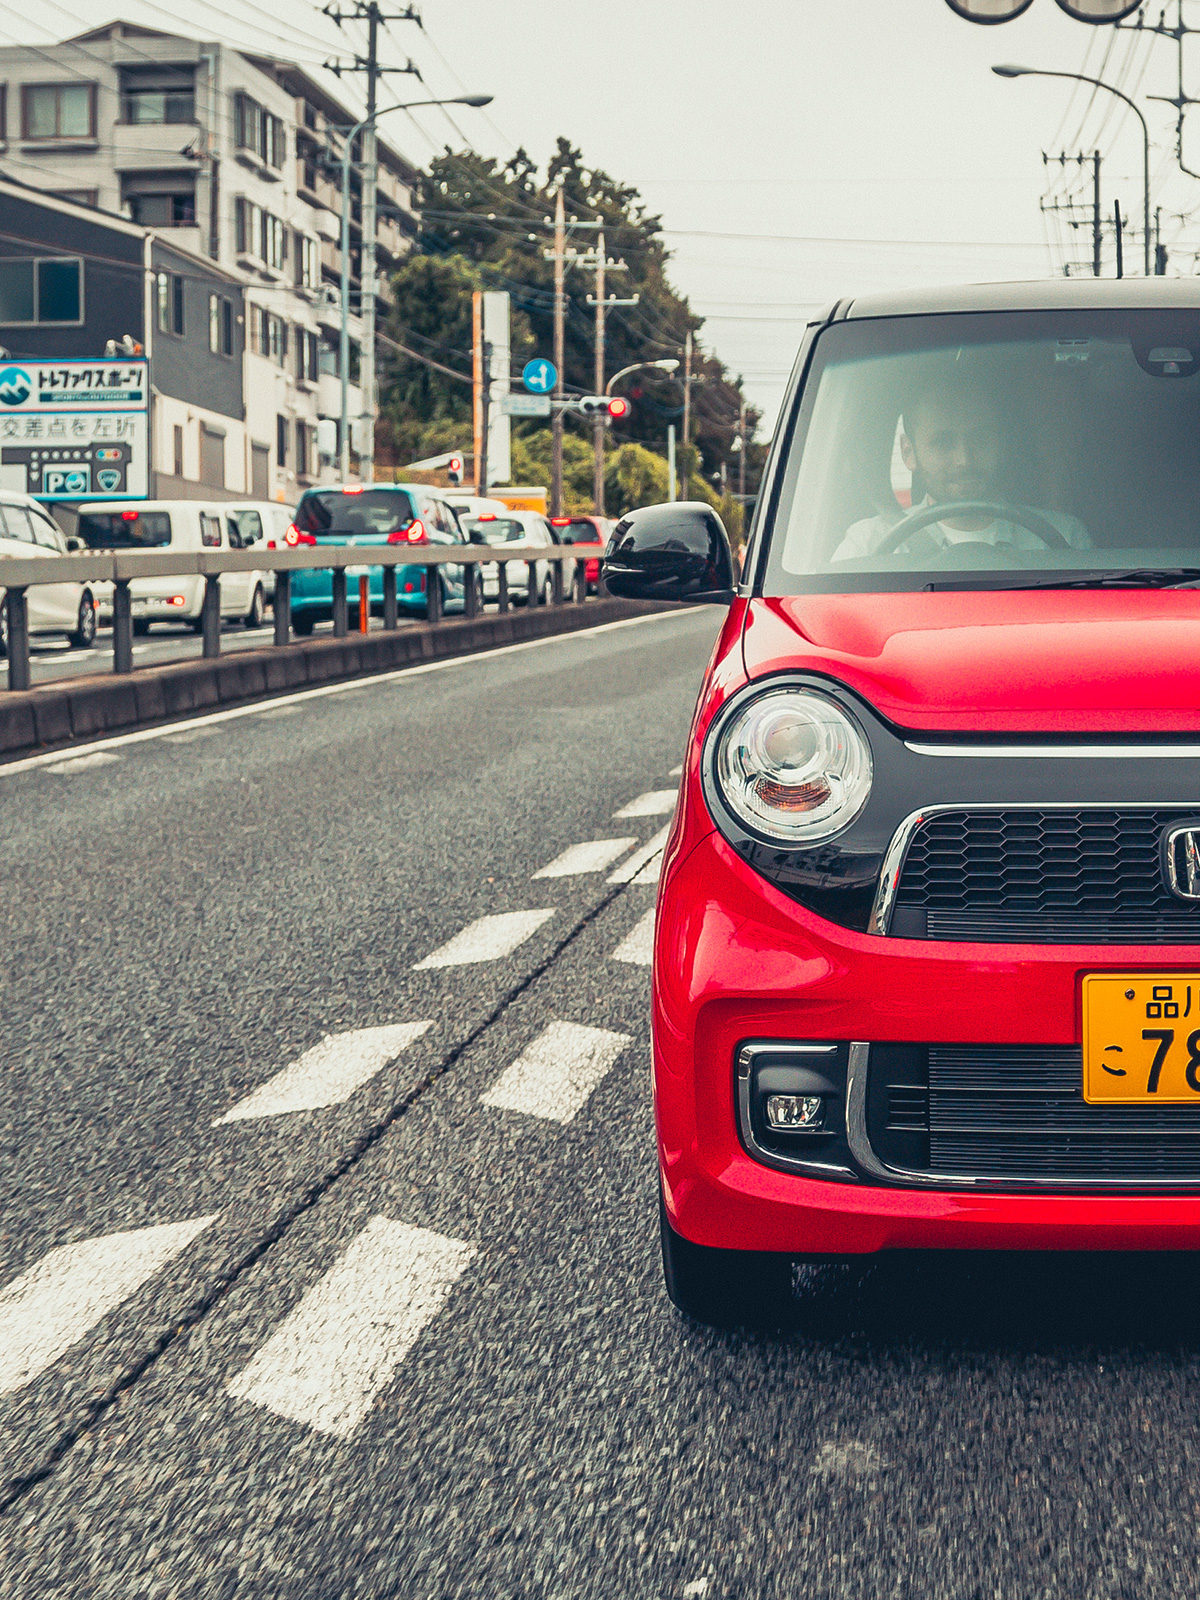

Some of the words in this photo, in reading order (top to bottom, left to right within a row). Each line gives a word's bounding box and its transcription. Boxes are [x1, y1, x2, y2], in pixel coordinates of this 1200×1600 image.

[1, 415, 136, 439] 交差点を左折
